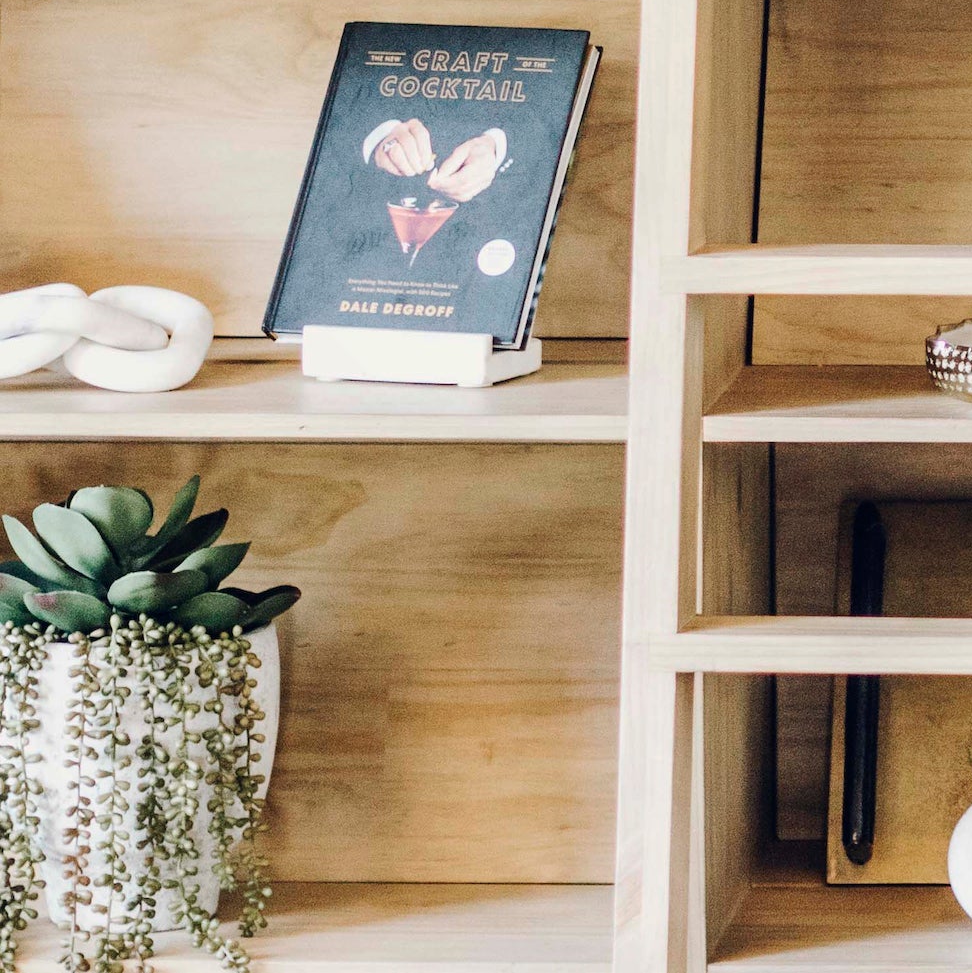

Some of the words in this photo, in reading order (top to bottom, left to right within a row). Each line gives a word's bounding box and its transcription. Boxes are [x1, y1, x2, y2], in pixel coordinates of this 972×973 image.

[371, 54, 383, 62] THE
[384, 55, 401, 63] NEW
[412, 49, 509, 74] CRAFT
[522, 60, 532, 68] OF
[533, 61, 547, 69] THE
[379, 75, 527, 103] COCKTAIL
[339, 299, 379, 314] DALE
[382, 302, 454, 318] DEGROFF
